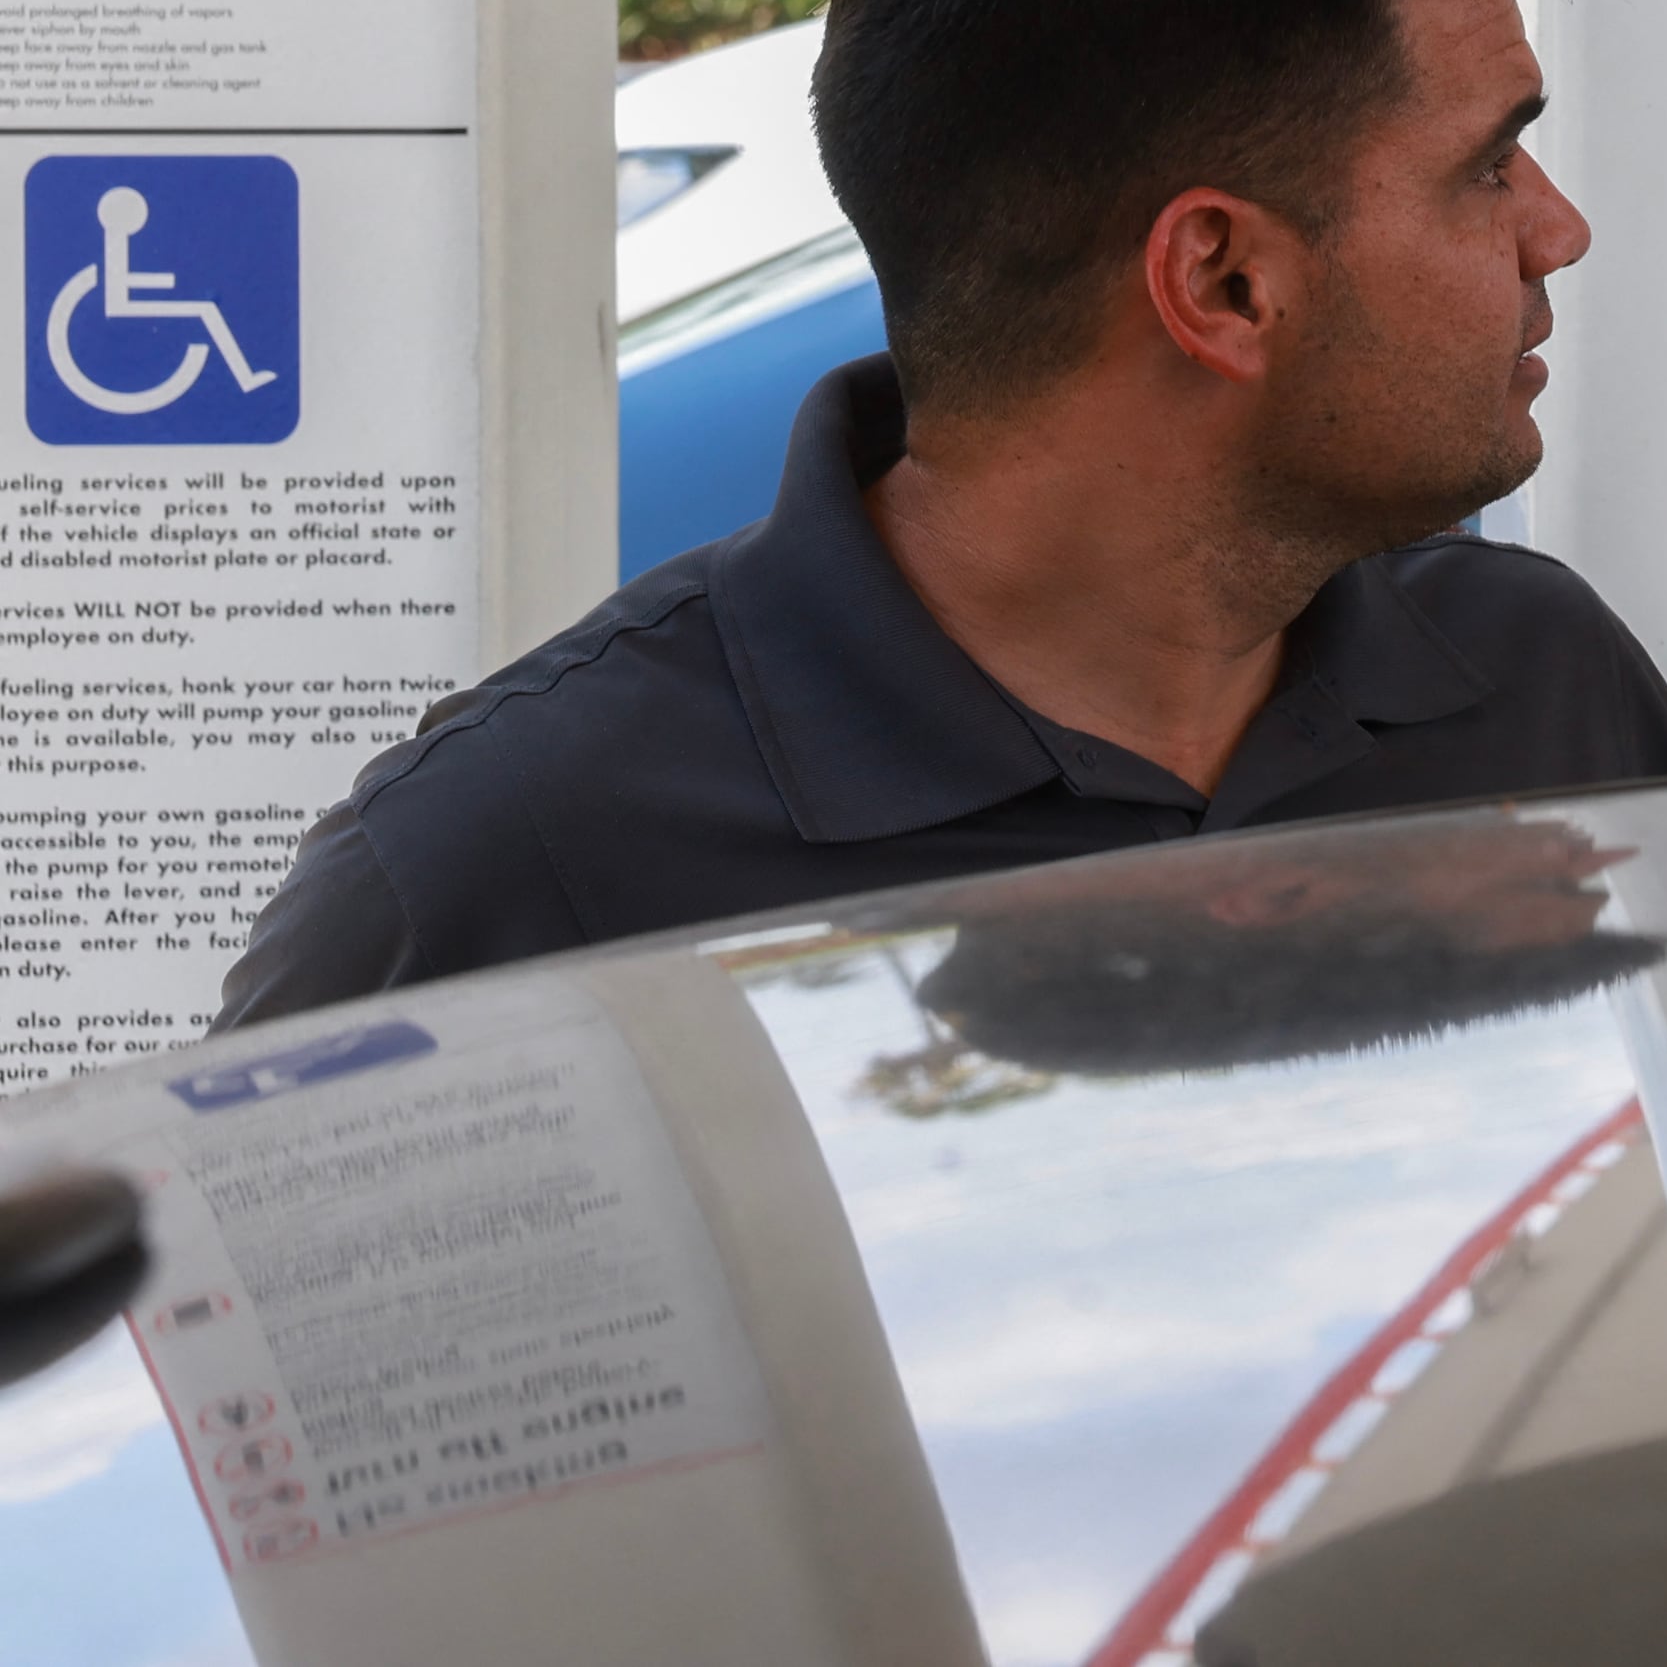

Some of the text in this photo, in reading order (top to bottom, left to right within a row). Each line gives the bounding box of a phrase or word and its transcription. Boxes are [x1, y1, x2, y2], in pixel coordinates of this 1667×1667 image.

[80, 470, 456, 494] services will be provided upon
